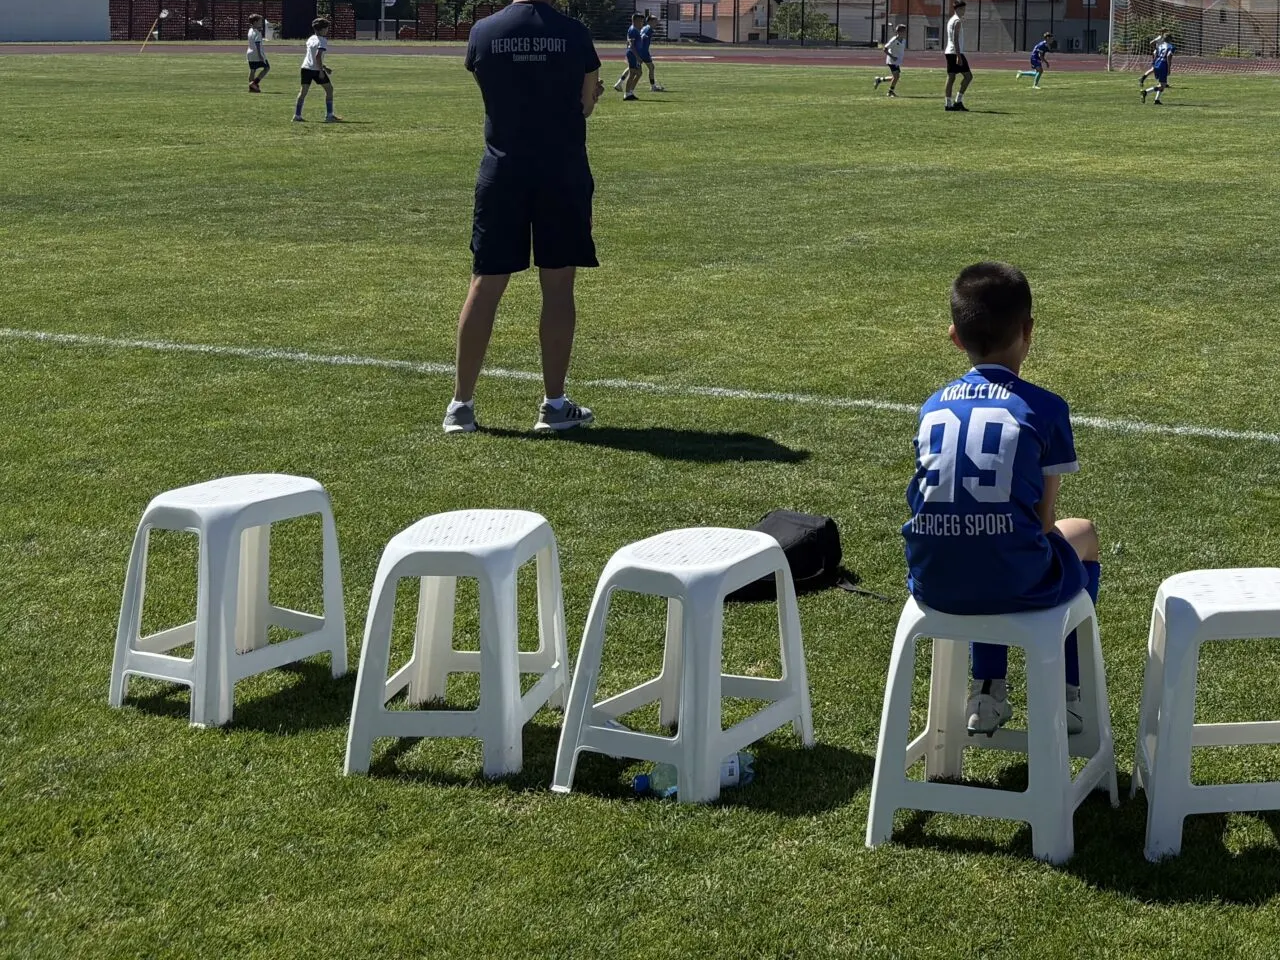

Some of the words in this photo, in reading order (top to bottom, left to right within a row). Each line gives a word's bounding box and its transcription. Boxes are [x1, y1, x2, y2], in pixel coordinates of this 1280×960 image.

[491, 37, 530, 54] HERCEG
[533, 37, 567, 53] SPORT
[918, 407, 1021, 503] 99
[911, 513, 962, 536] HERCEG
[965, 513, 1014, 536] SPORT
